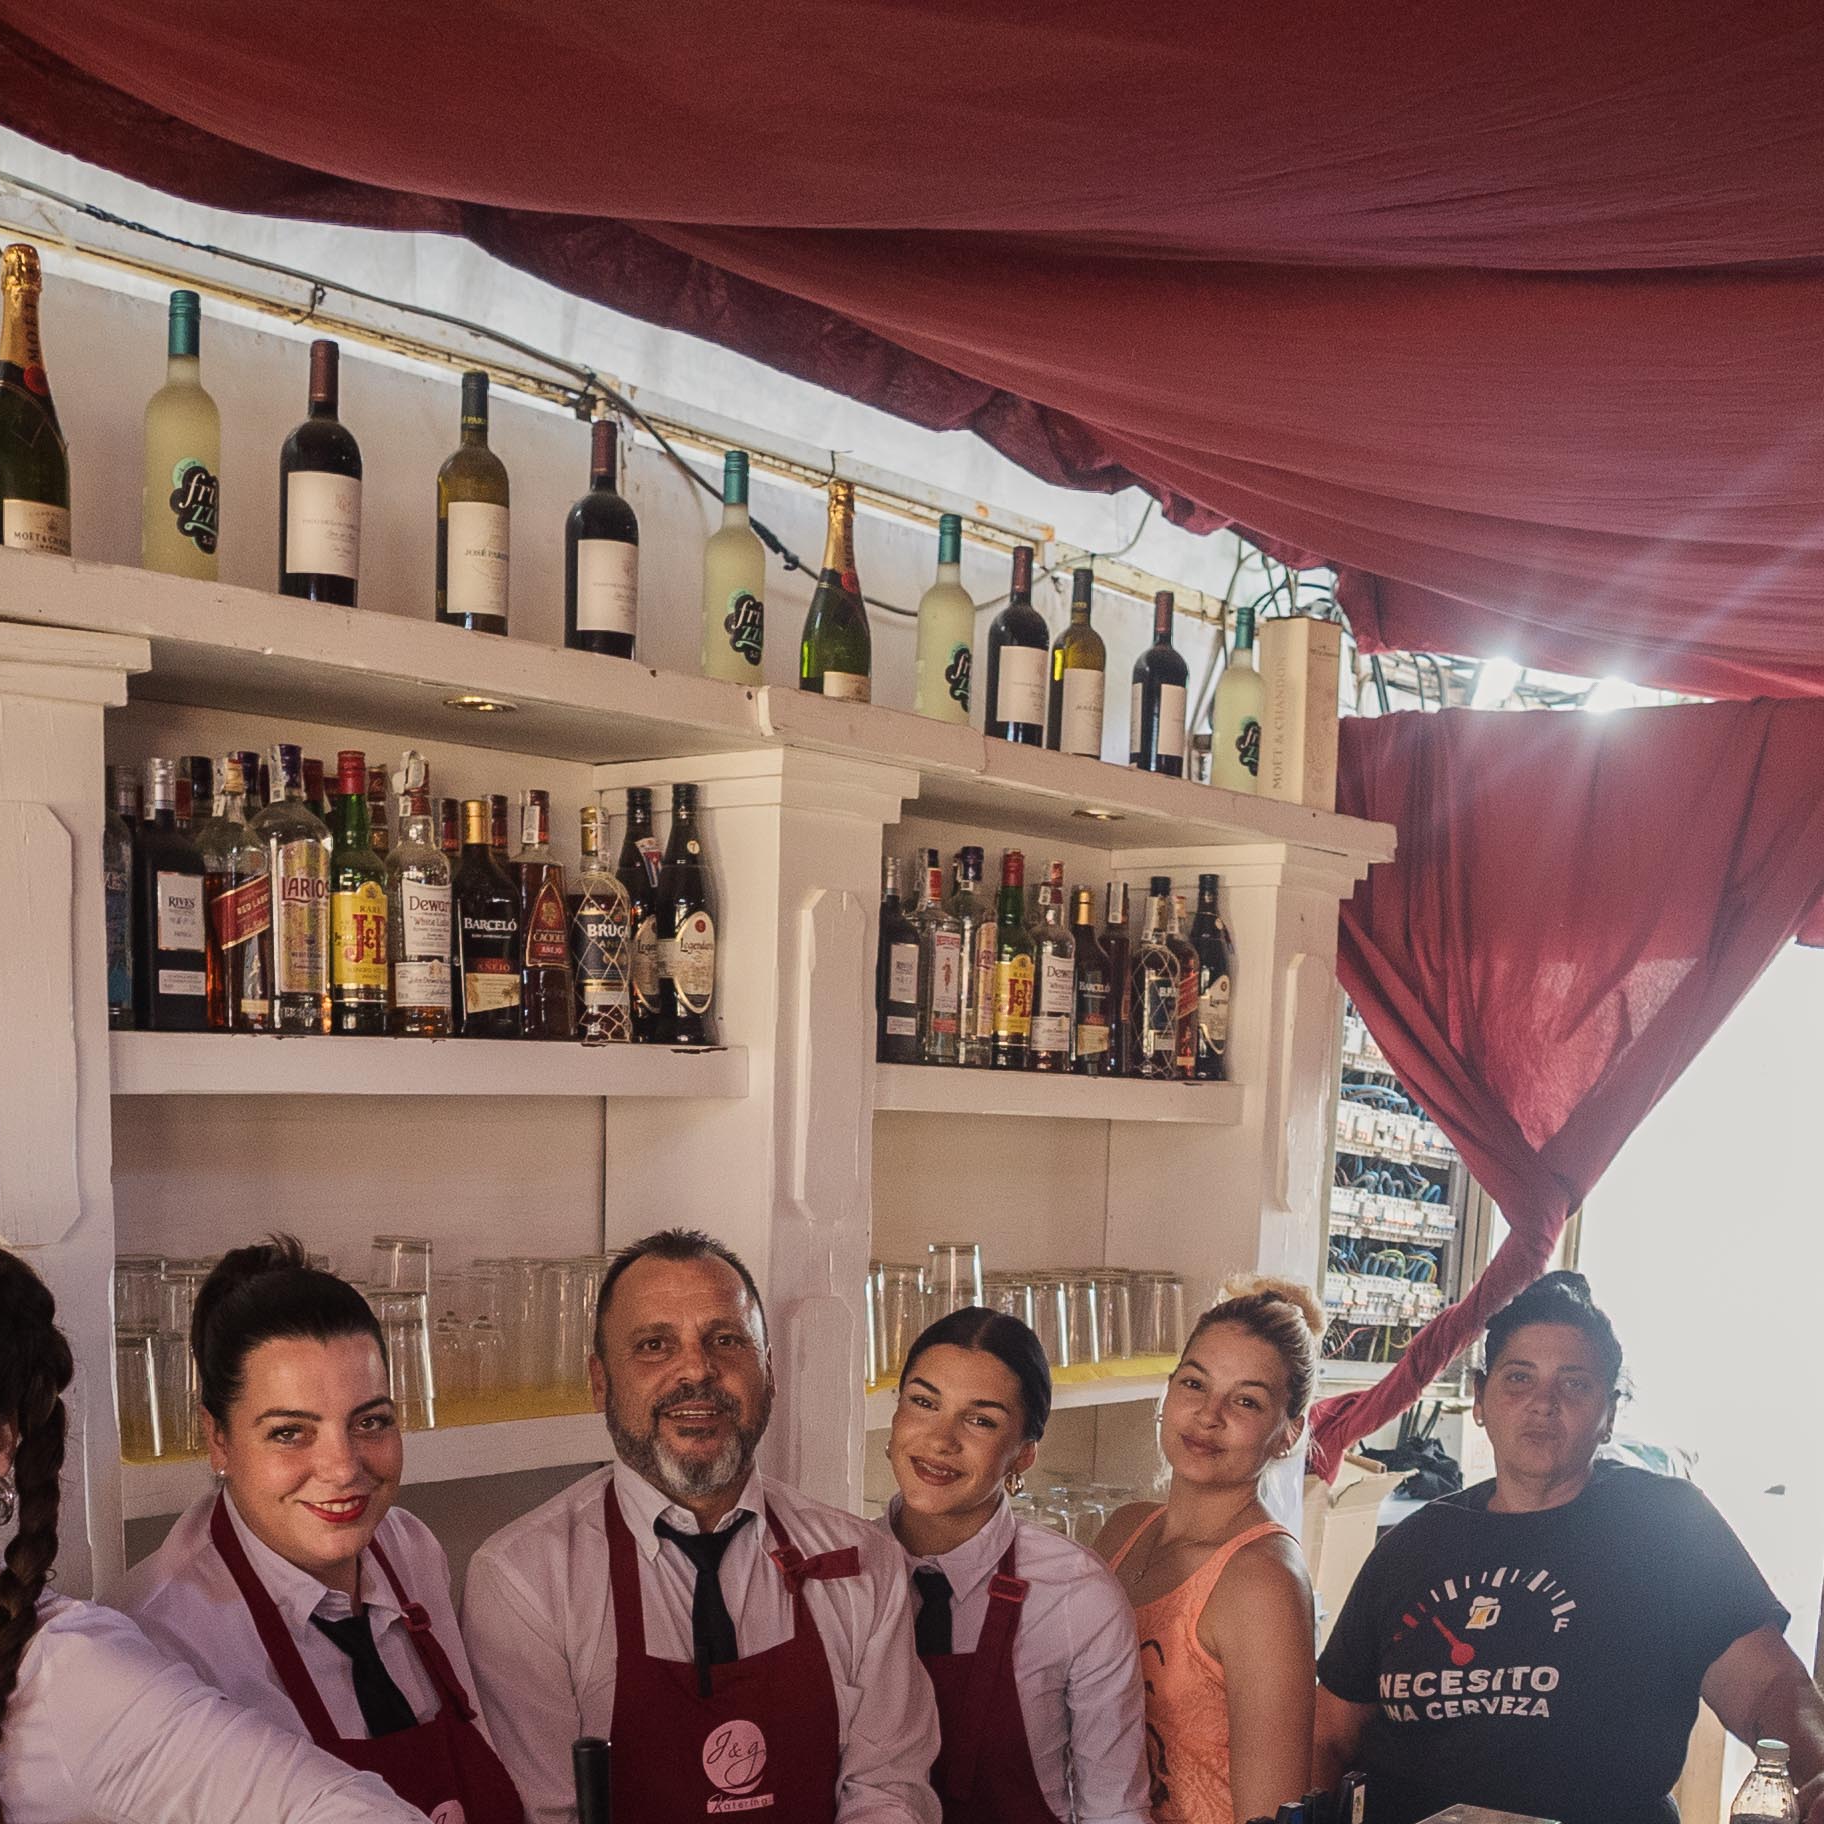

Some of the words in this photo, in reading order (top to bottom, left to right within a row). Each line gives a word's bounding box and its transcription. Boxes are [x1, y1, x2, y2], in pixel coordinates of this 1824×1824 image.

[168, 895, 195, 909] RIVES
[464, 917, 517, 931] BARCELÓ
[1553, 1617, 1570, 1633] F
[1379, 1665, 1560, 1699] NECESITO
[1426, 1695, 1550, 1721] CERVEZA
[707, 1794, 769, 1814] Katering
